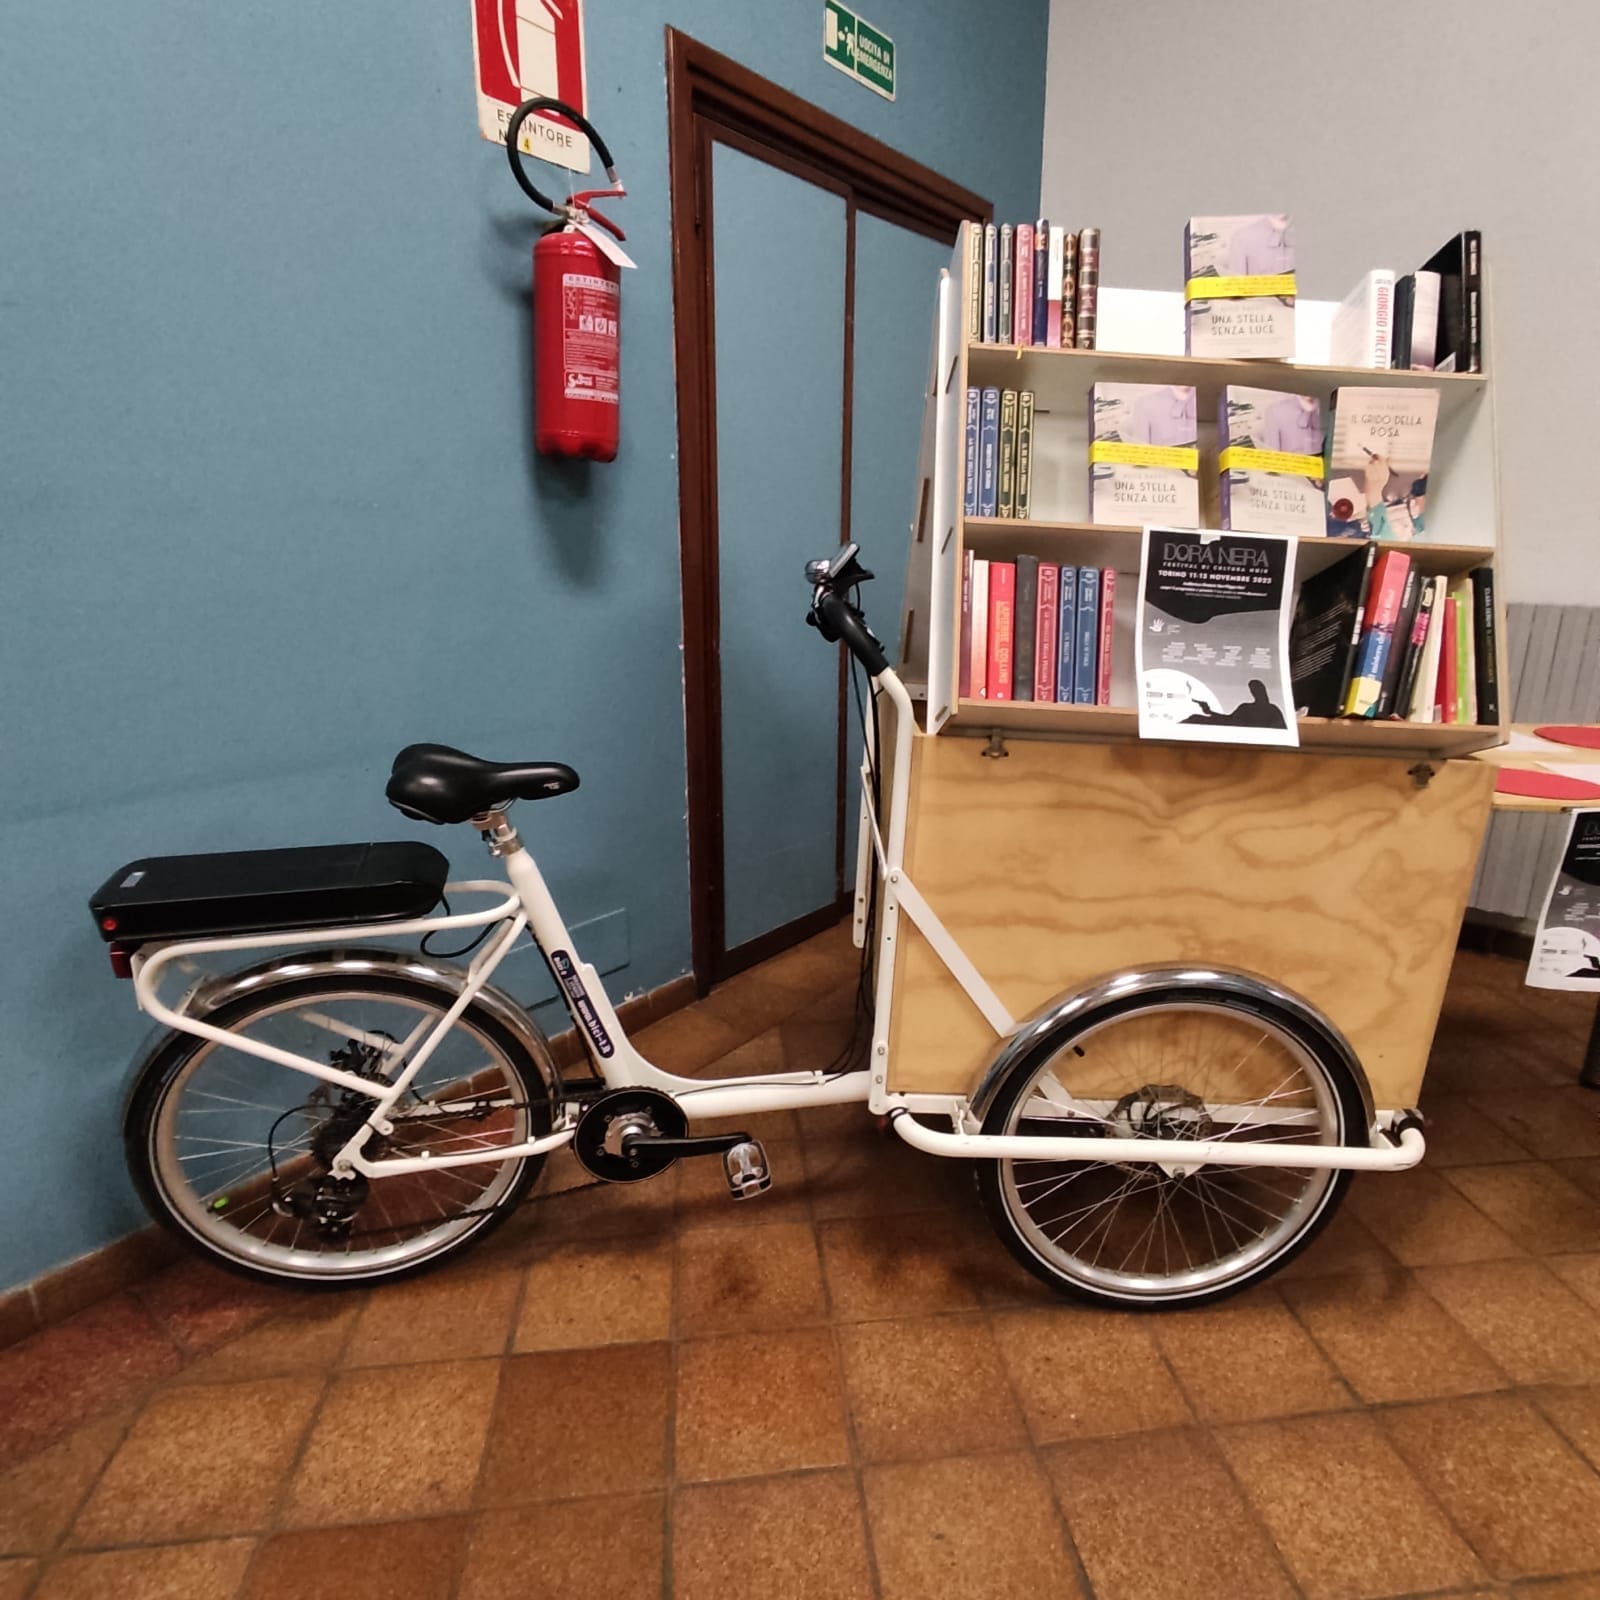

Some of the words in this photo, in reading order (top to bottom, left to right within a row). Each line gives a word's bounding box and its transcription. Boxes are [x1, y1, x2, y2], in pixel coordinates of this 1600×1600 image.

[497, 108, 573, 148] ESINTORE
[1375, 286, 1389, 328] GIORGIO
[1211, 314, 1232, 325] UNA
[1236, 313, 1273, 324] STELLA
[1211, 325, 1245, 336] SENZA
[1249, 325, 1274, 335] LUCE
[1361, 414, 1391, 425] GRIDO
[1394, 415, 1422, 426] DELLA
[1370, 426, 1400, 438] ROSA
[1114, 481, 1135, 491] UNA
[1140, 481, 1177, 492] STELLA
[1113, 492, 1148, 502] SENZA
[1152, 494, 1177, 504] LUCE
[1272, 489, 1305, 501] STELLA
[1284, 501, 1306, 513] LUCE
[1163, 542, 1214, 564] DORA
[1218, 546, 1269, 568] NERA
[1163, 561, 1198, 570] FESTIVAL
[1158, 569, 1187, 579] TORINO
[1209, 573, 1250, 583] NOVEMBRE
[999, 647, 1009, 684] COLLINS
